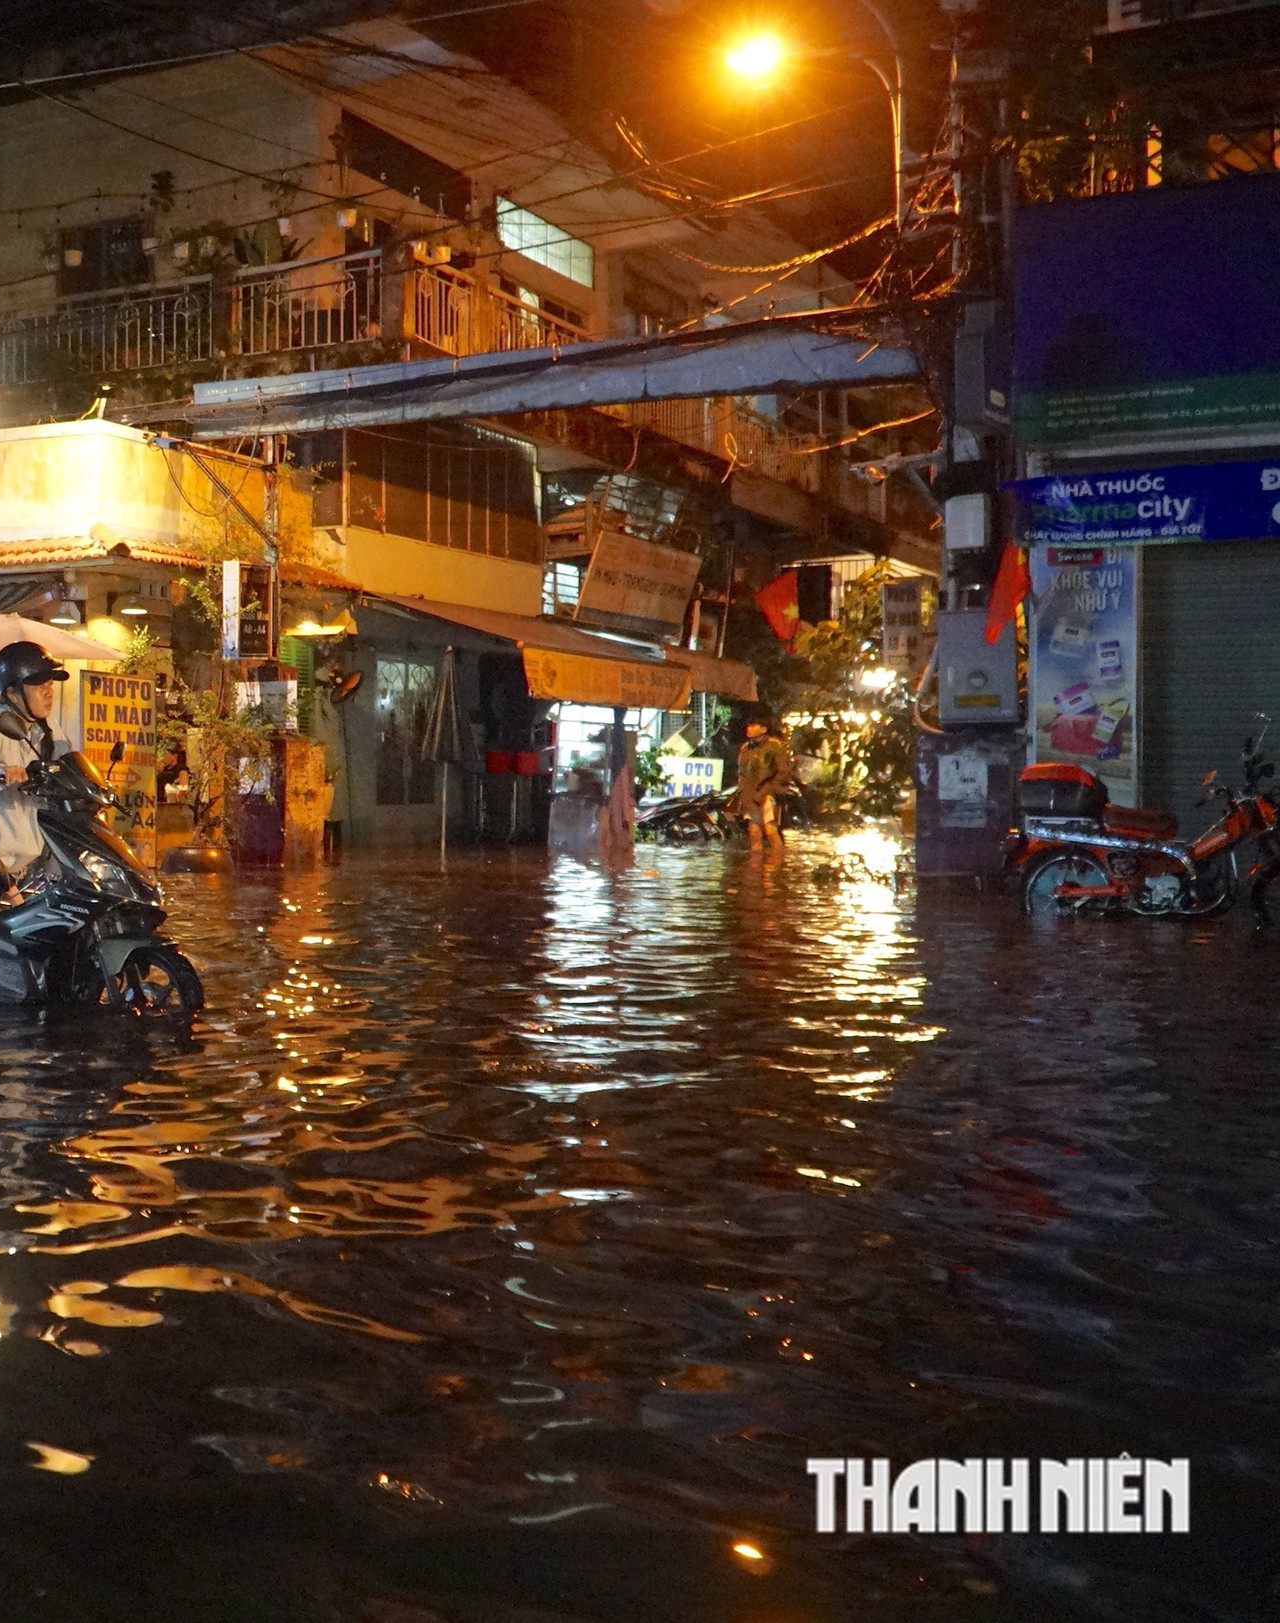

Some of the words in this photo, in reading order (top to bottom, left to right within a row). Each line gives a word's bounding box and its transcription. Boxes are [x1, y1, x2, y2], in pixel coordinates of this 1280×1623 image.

[1052, 480, 1093, 498] NHÀ
[1097, 473, 1165, 496] THUỐC
[89, 675, 152, 702] PHOTO
[88, 703, 108, 723] IN
[114, 702, 153, 727] MÀU
[86, 727, 122, 745] SCAN
[126, 727, 156, 747] MÀU
[131, 811, 155, 830] A4
[60, 903, 90, 915] HONDA
